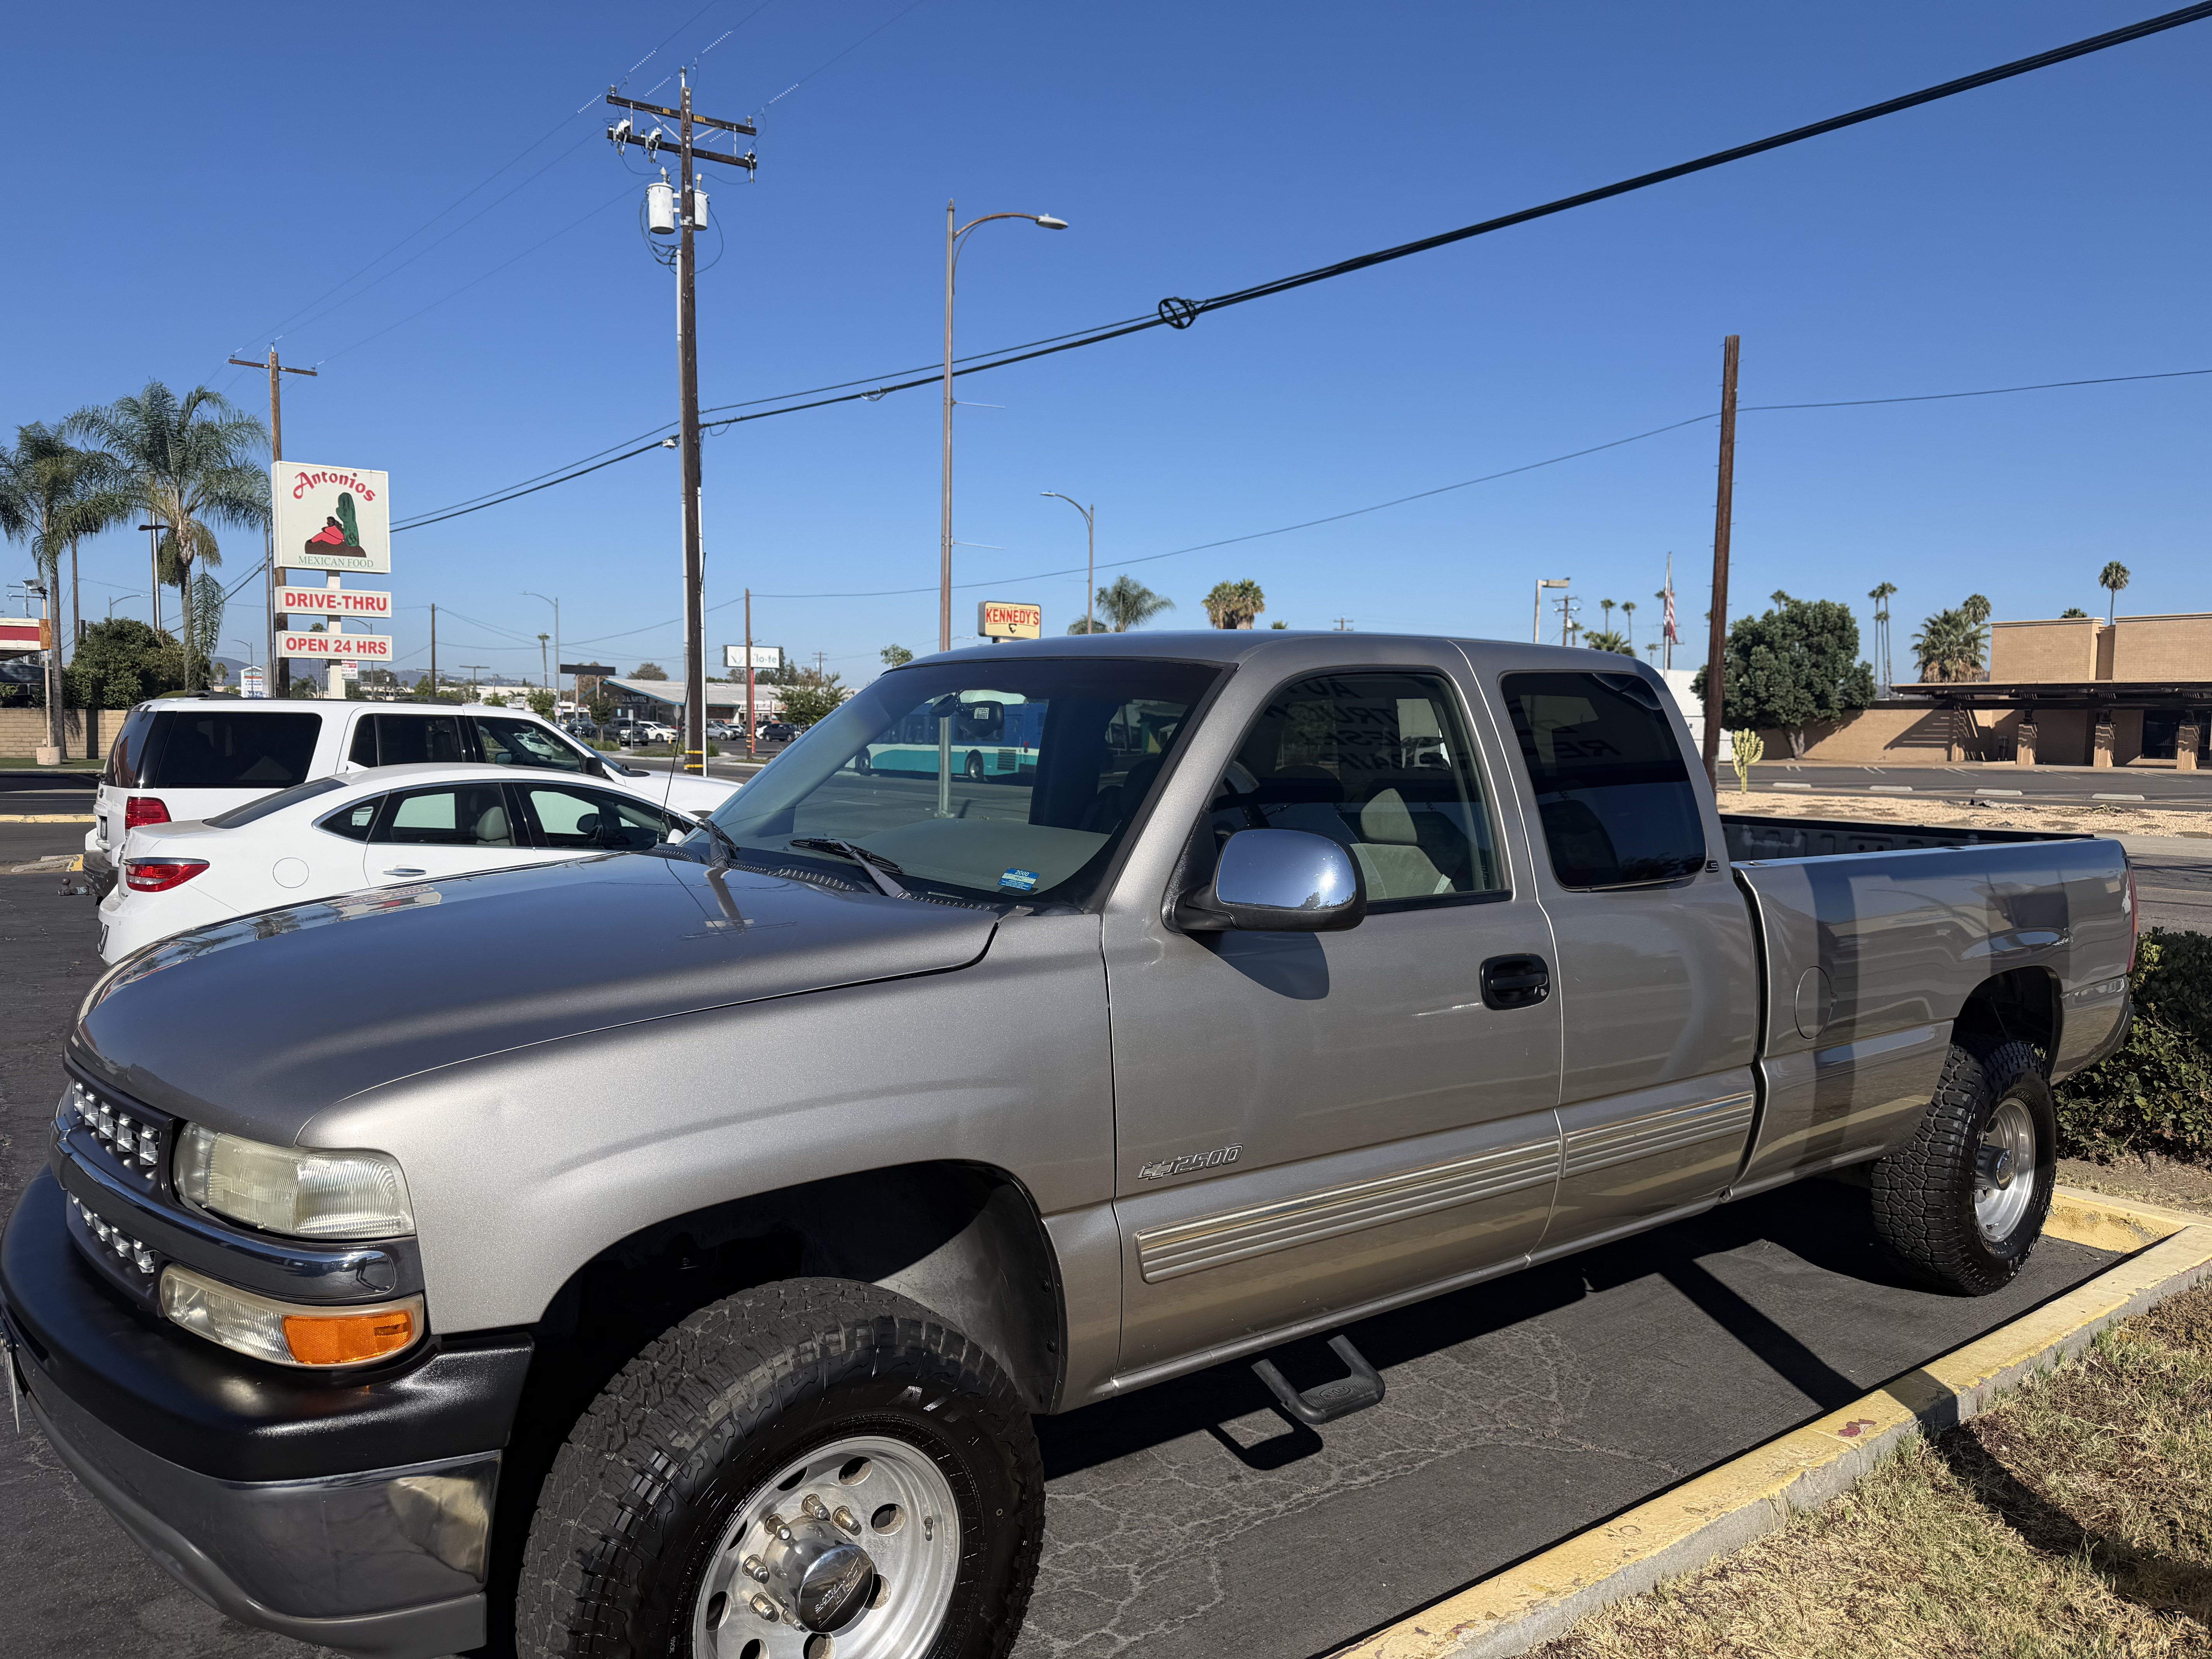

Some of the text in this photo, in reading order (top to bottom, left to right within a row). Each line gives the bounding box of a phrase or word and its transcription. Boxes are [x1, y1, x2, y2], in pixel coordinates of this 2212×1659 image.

[293, 471, 376, 501] Antonios
[298, 555, 374, 568] MEXICAN FOOD
[285, 592, 386, 611] DRIVE-THRU
[986, 608, 1039, 625] KENNEDY'S
[286, 637, 387, 654] OPEN 24 HRS
[1173, 1143, 1243, 1175] 2500
